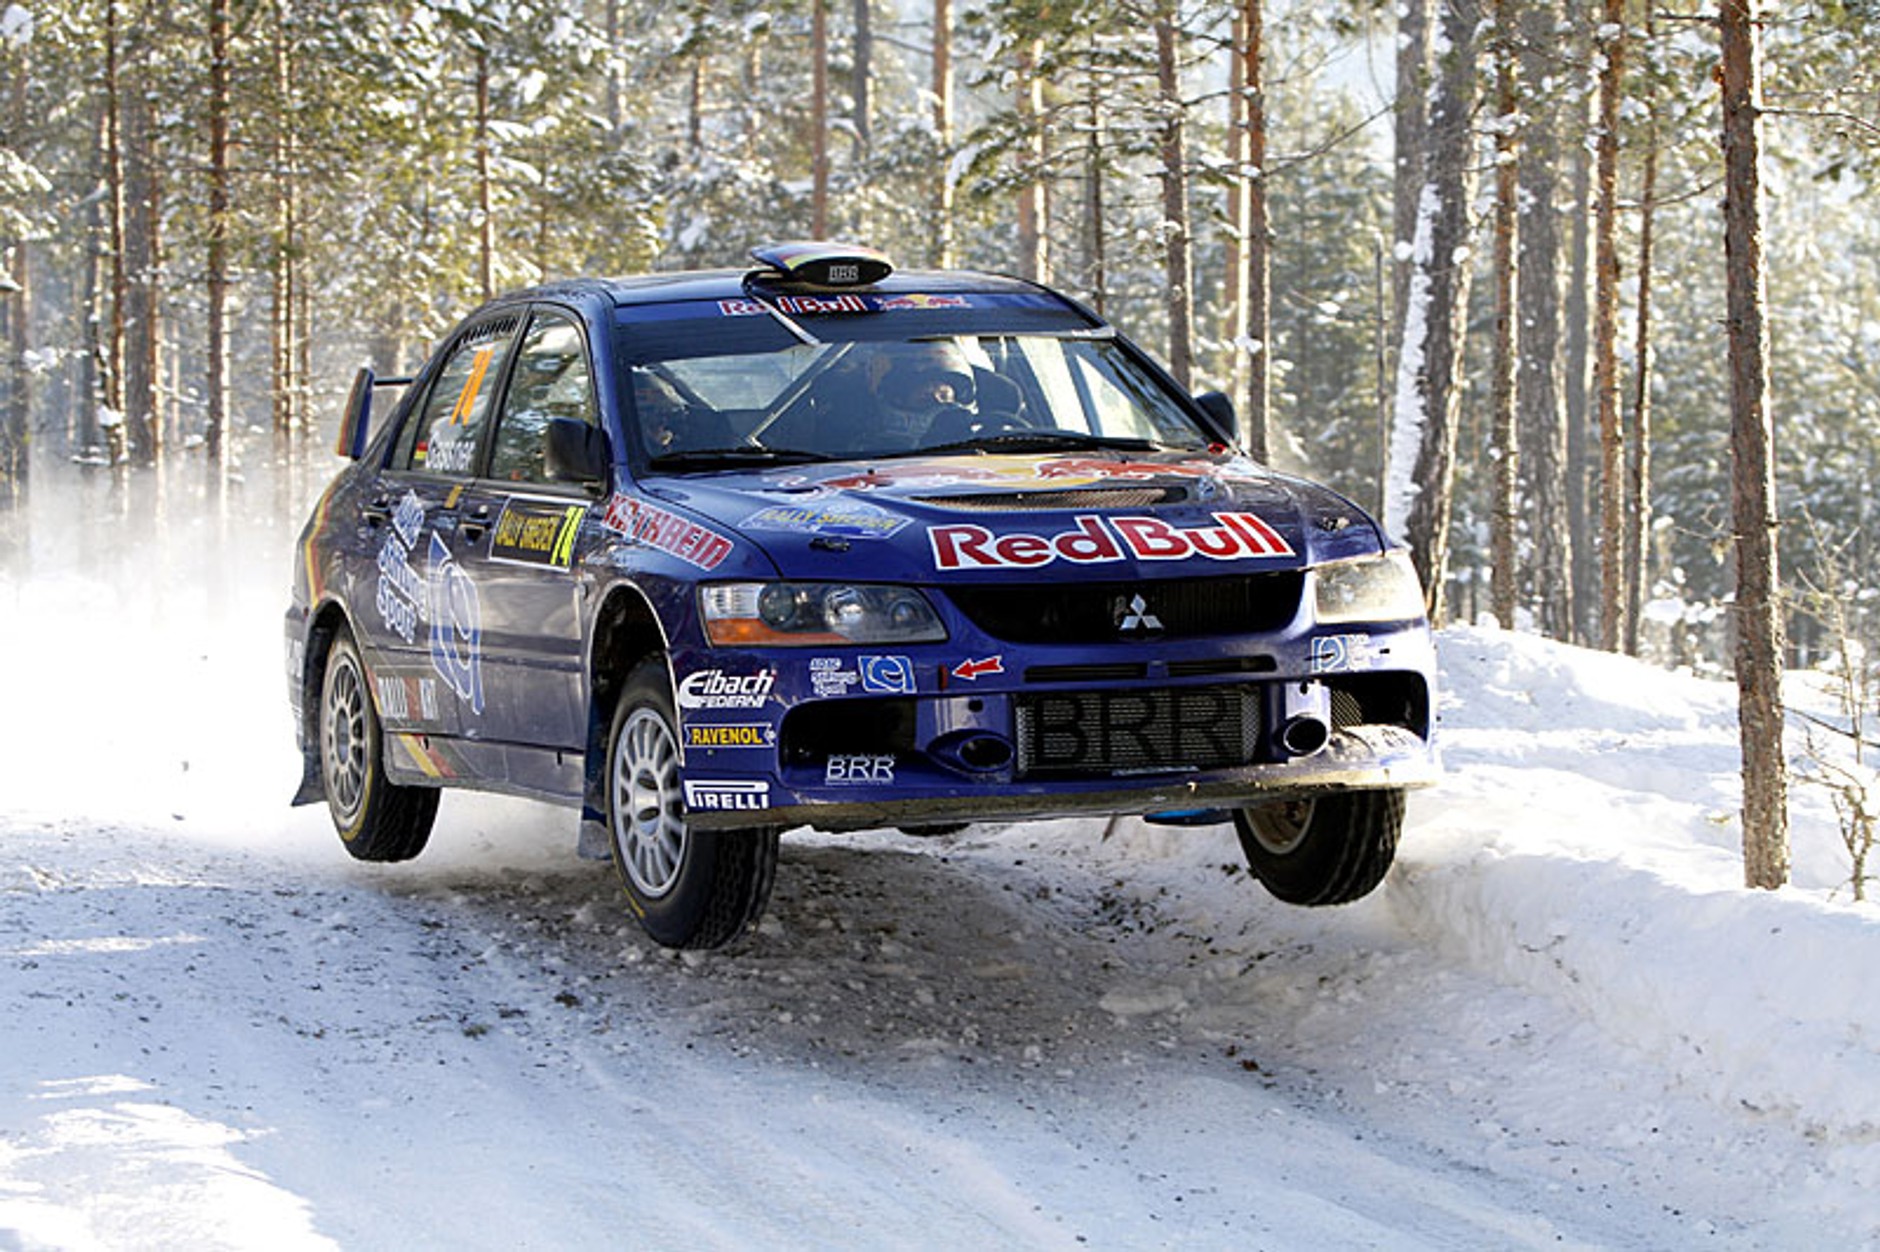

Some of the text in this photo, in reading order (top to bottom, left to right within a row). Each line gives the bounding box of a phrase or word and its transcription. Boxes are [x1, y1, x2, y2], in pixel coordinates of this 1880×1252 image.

[793, 295, 868, 313] Bull
[928, 512, 1293, 569] Red Bull
[679, 669, 775, 708] Eibach
[691, 727, 763, 745] RAVENOL
[1034, 690, 1234, 767] BRR
[827, 757, 895, 781] BRR
[684, 780, 769, 810] PIRELLI
